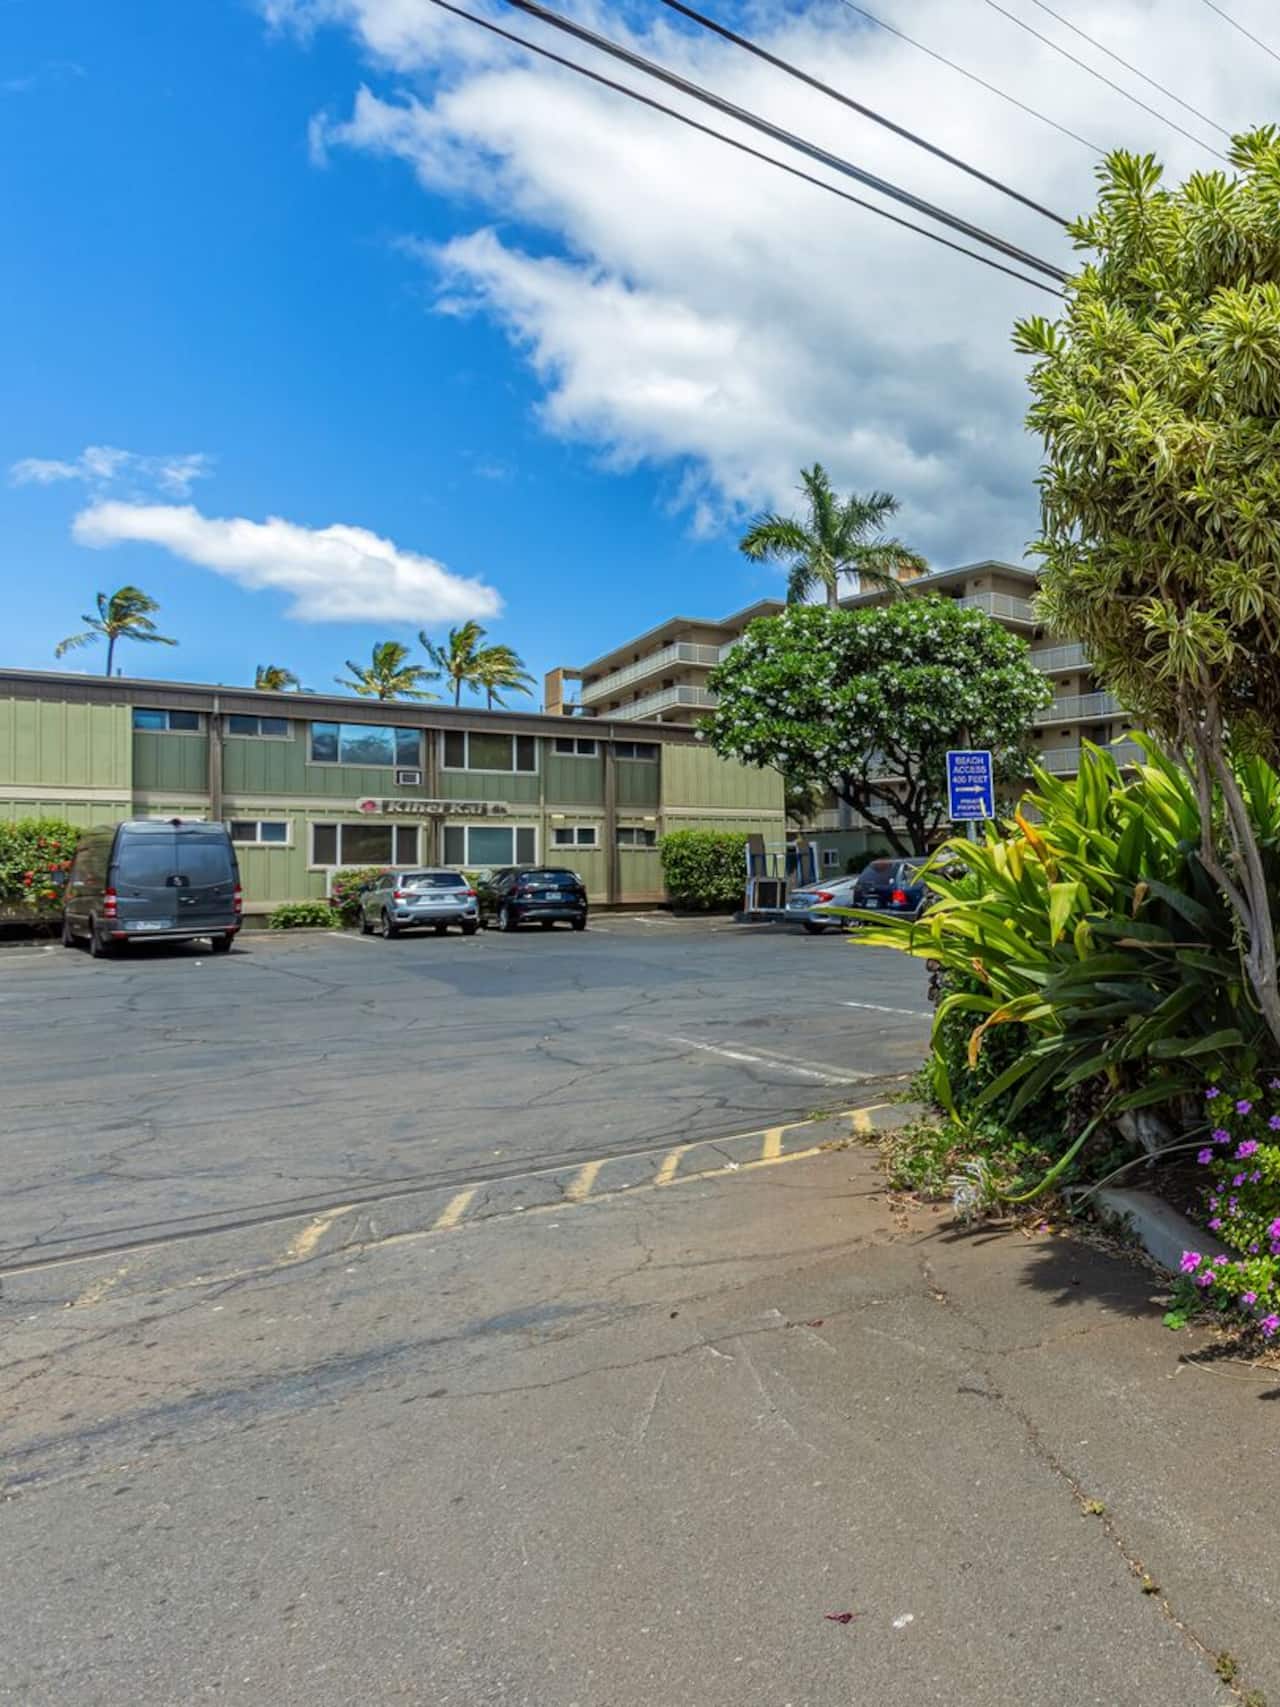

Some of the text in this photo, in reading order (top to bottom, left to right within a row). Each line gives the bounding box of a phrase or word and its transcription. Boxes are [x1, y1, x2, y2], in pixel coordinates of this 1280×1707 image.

[955, 756, 984, 765] BEACH
[953, 766, 987, 774] ACCESS
[968, 775, 988, 784] FEET
